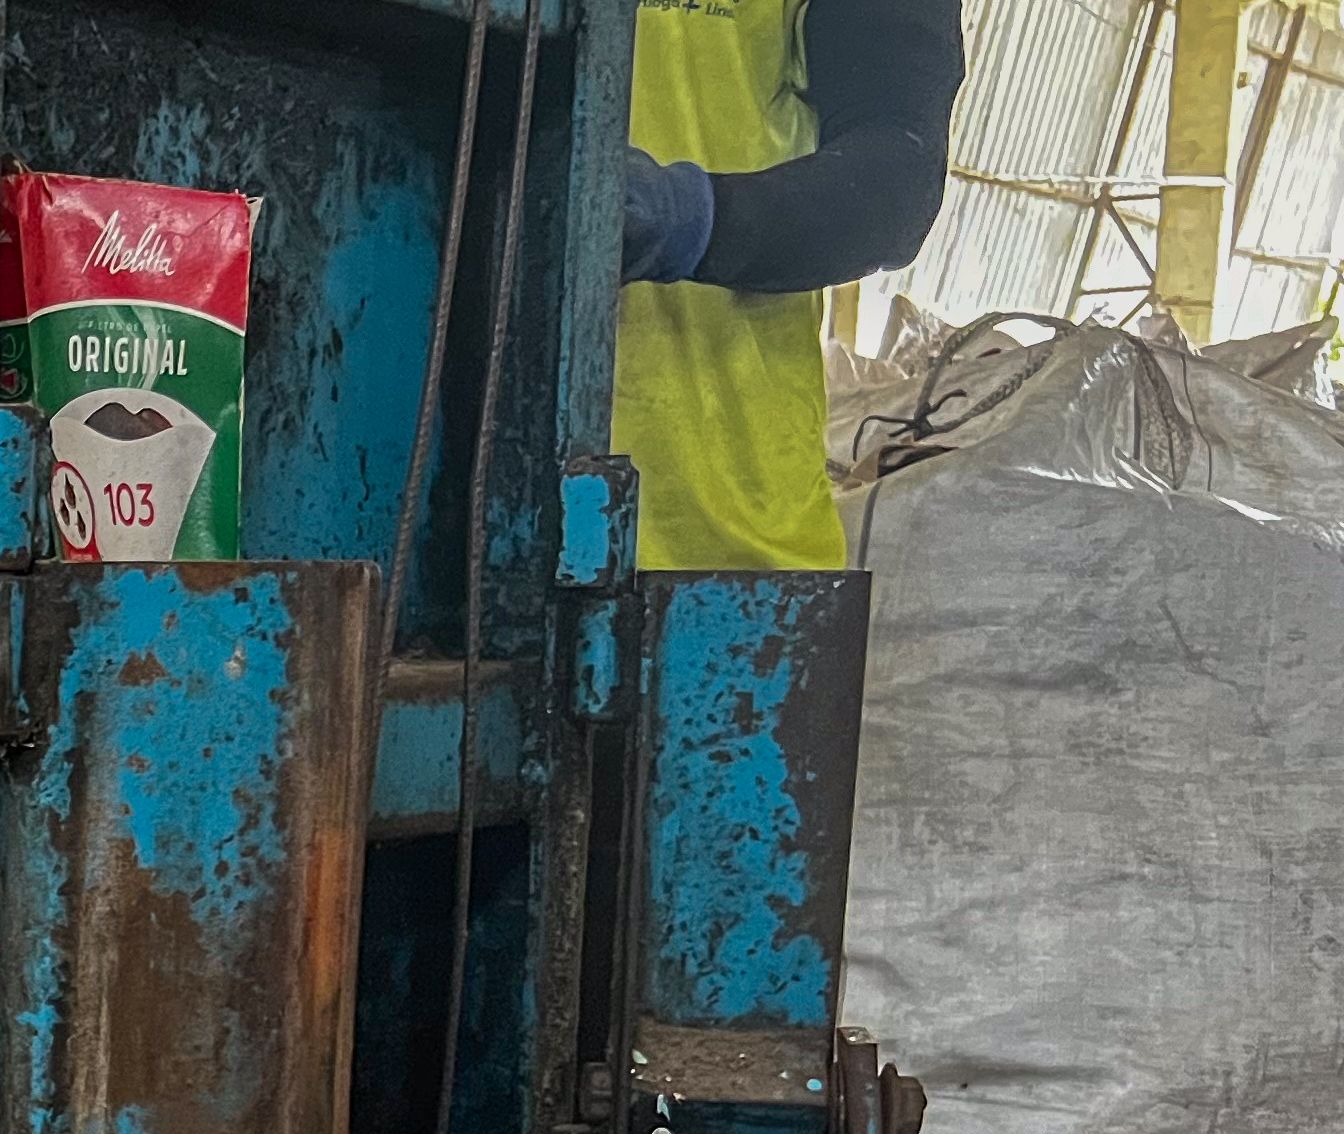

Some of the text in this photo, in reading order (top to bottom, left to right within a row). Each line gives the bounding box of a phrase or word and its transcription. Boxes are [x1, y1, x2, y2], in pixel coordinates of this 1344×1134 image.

[81, 210, 175, 276] Melitta
[68, 335, 188, 376] ORIGINAL
[104, 483, 155, 527] 103
